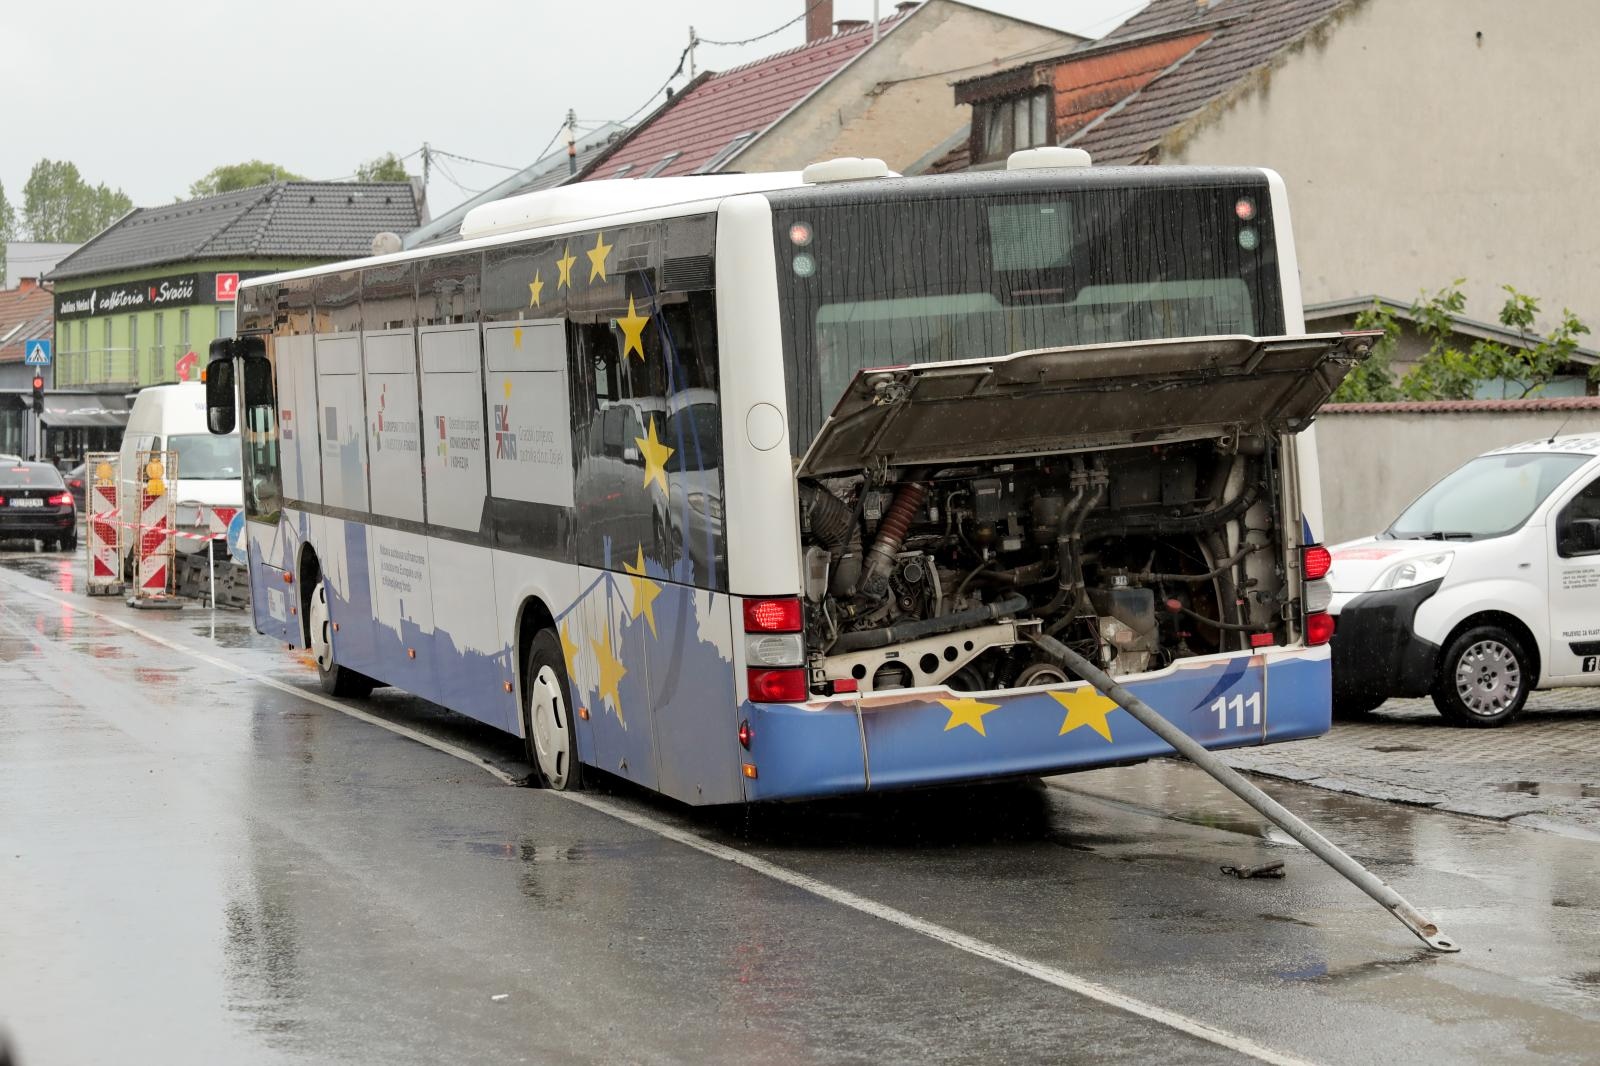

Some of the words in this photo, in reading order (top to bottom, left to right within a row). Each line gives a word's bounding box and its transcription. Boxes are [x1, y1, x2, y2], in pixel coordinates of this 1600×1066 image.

[60, 300, 76, 314] Julius
[75, 298, 90, 312] Meinl
[1210, 691, 1261, 730] 111
